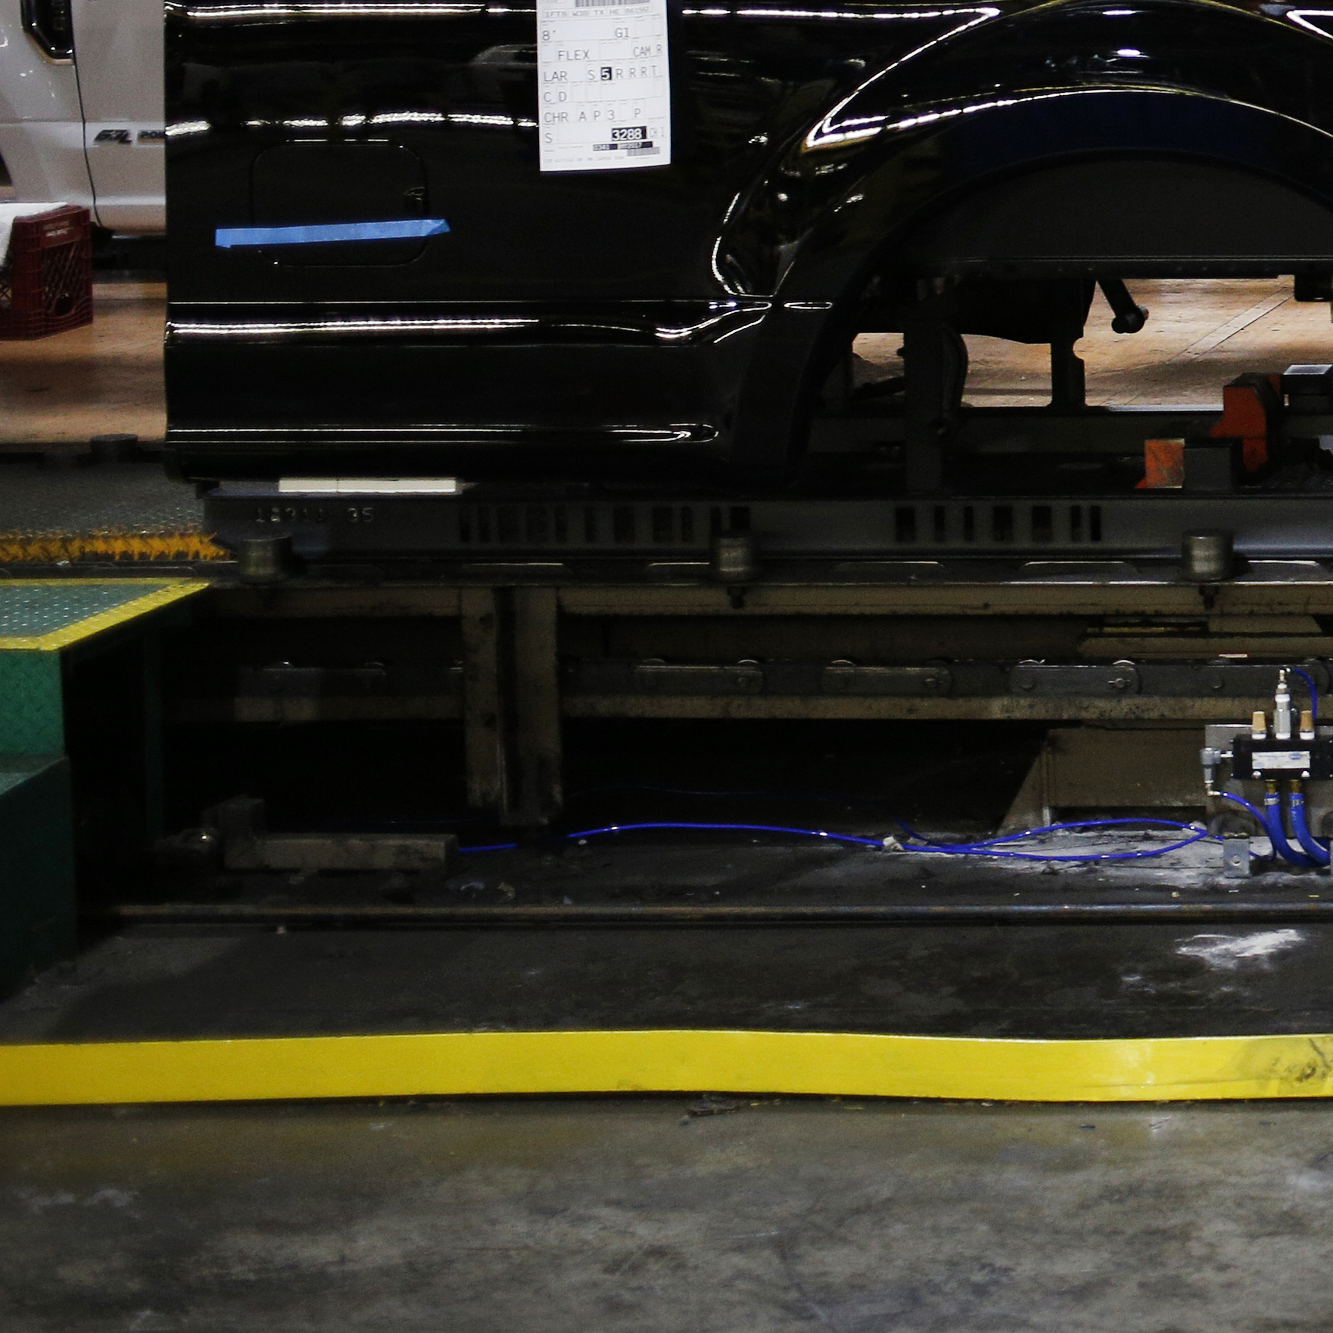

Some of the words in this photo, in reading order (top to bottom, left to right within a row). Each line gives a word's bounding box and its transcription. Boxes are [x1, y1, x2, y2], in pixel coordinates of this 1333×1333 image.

[614, 27, 630, 39] G1
[558, 49, 591, 61] FLEX
[633, 46, 651, 57] CAM
[543, 70, 568, 82] LAR
[587, 69, 596, 81] S
[601, 68, 611, 80] 5
[615, 68, 624, 79] R
[629, 67, 637, 78] R
[641, 66, 648, 78] R
[651, 65, 657, 76] T
[543, 91, 552, 103] C
[558, 91, 567, 102] D
[543, 111, 569, 123] CHR
[578, 111, 587, 122] A
[593, 110, 601, 121] P
[607, 109, 615, 121] 3
[634, 107, 641, 119] P
[545, 132, 553, 144] S
[612, 128, 643, 141] 3288
